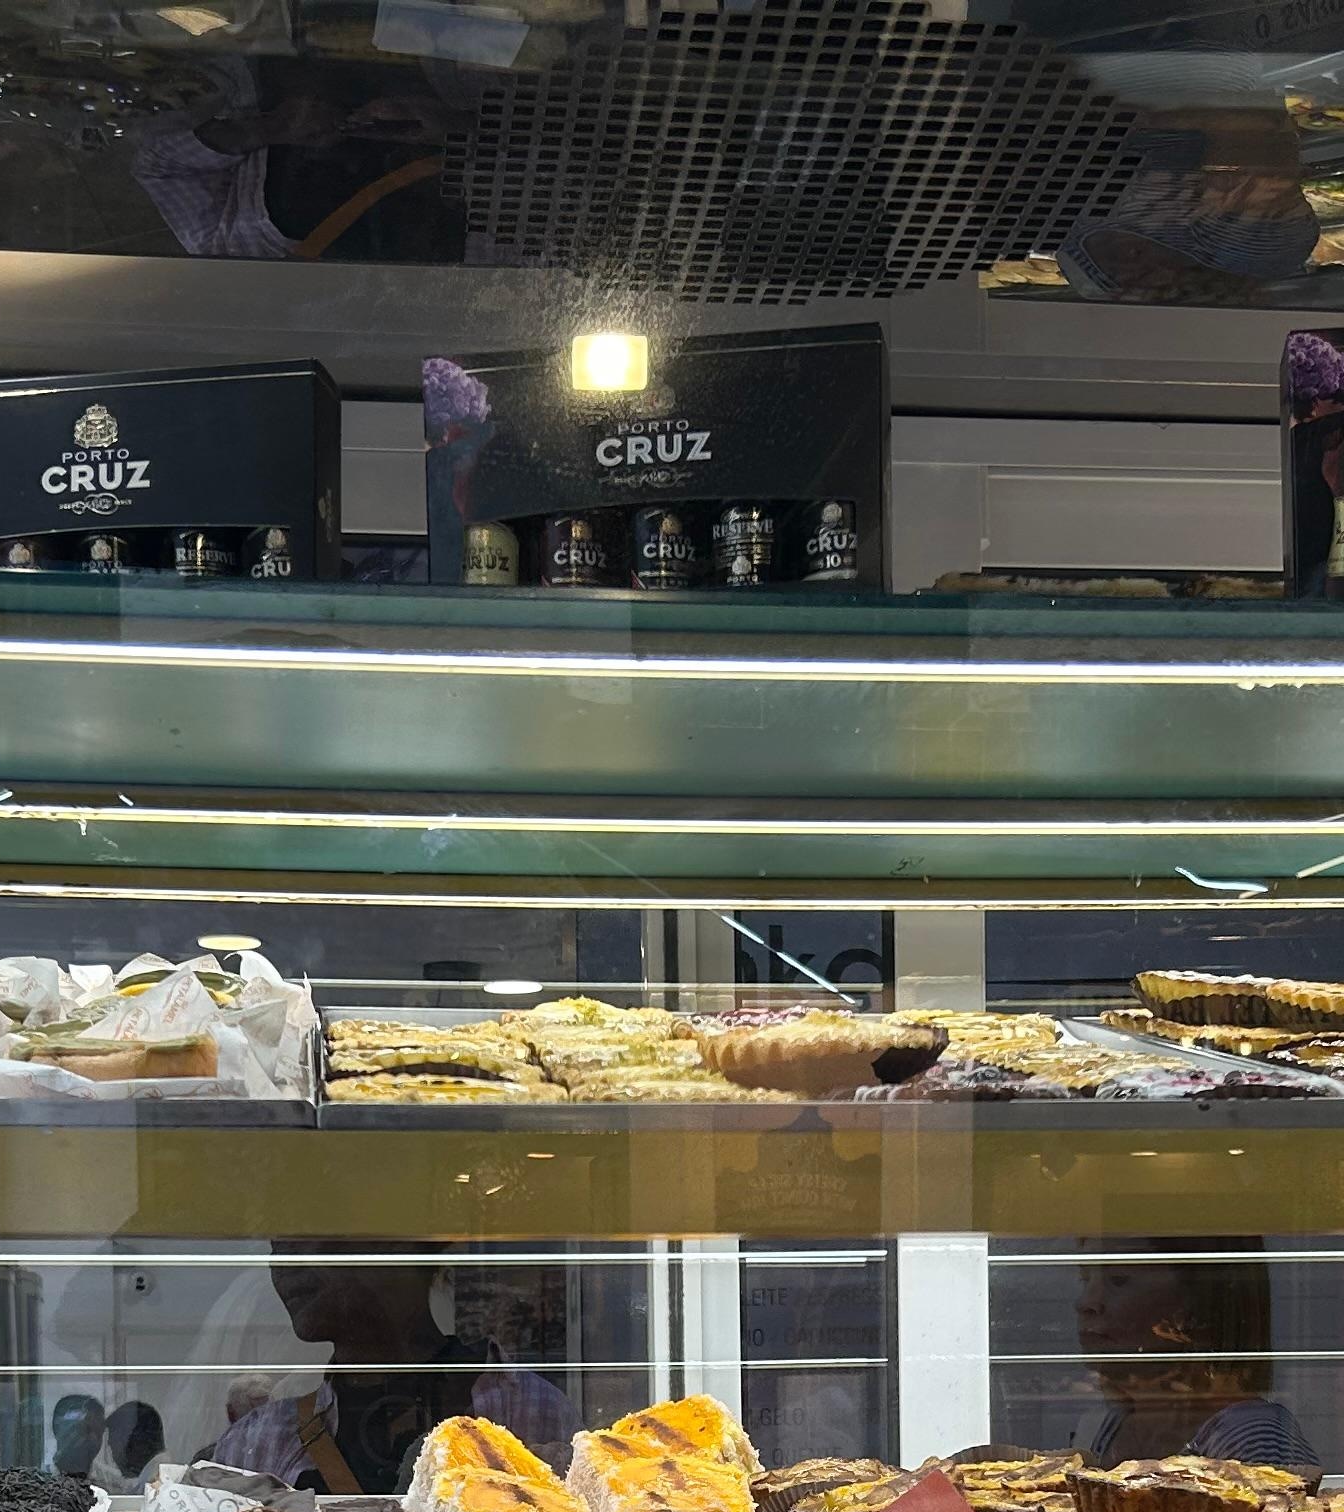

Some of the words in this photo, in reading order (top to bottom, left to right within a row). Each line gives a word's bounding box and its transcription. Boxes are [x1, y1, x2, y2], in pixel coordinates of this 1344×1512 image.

[618, 420, 689, 435] PORTO
[62, 448, 130, 463] PORTO
[595, 431, 712, 467] CRUZ
[41, 460, 150, 494] CRUZ
[554, 549, 607, 568] CRUZ
[643, 542, 696, 562] CRUZ
[250, 559, 292, 578] CRU
[464, 555, 509, 571] RUZ
